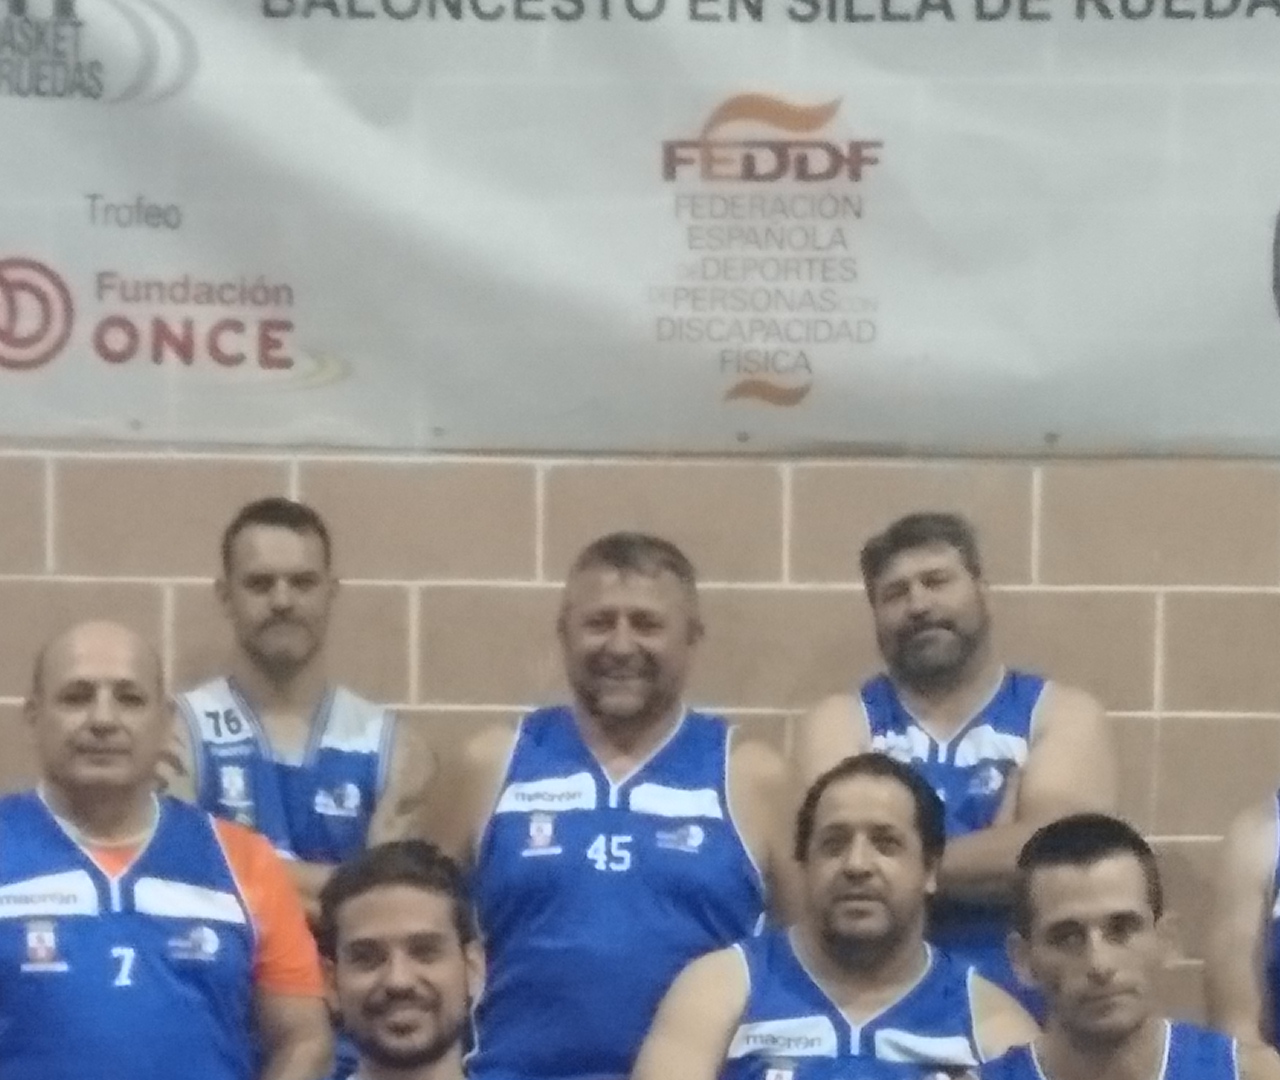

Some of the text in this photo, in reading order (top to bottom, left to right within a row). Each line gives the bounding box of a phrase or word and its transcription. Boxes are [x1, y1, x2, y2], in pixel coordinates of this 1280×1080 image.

[262, 0, 665, 21] BALONCESTO
[689, 0, 763, 22] EN
[787, 0, 956, 23] SILLA
[662, 139, 883, 183] FEDDF
[85, 193, 183, 230] Trofeo
[673, 190, 864, 220] FEDERACIÓN
[700, 257, 859, 283] DEPORTES
[94, 270, 295, 308] Fundación
[673, 287, 838, 313] PERSONAS
[92, 315, 296, 370] ONCE
[656, 316, 878, 344] DISCAPACIDAD
[204, 709, 242, 738] 76
[586, 833, 633, 872] 45
[110, 946, 136, 988] 7
